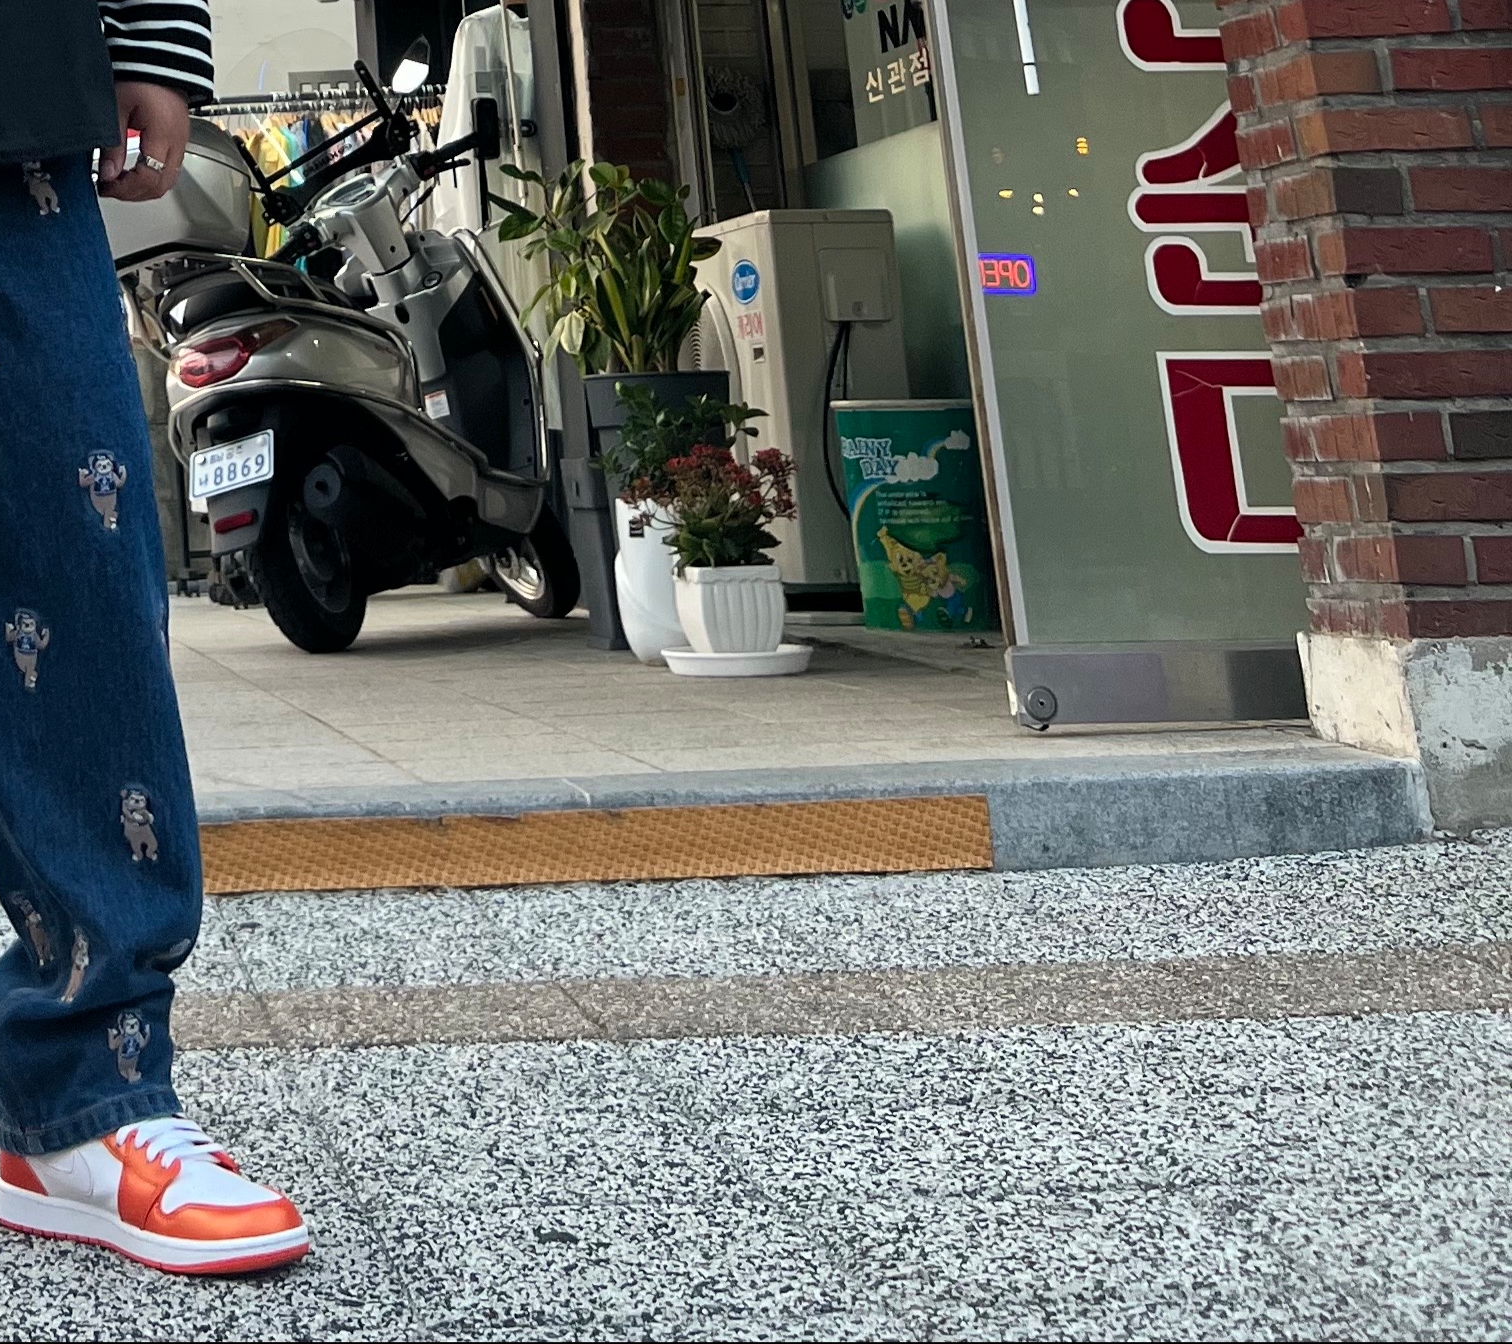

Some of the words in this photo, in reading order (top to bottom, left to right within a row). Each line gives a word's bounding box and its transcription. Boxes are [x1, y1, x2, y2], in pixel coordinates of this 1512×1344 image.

[865, 47, 931, 103] 신관점
[214, 454, 264, 485] 8869
[859, 458, 900, 478] DAY
